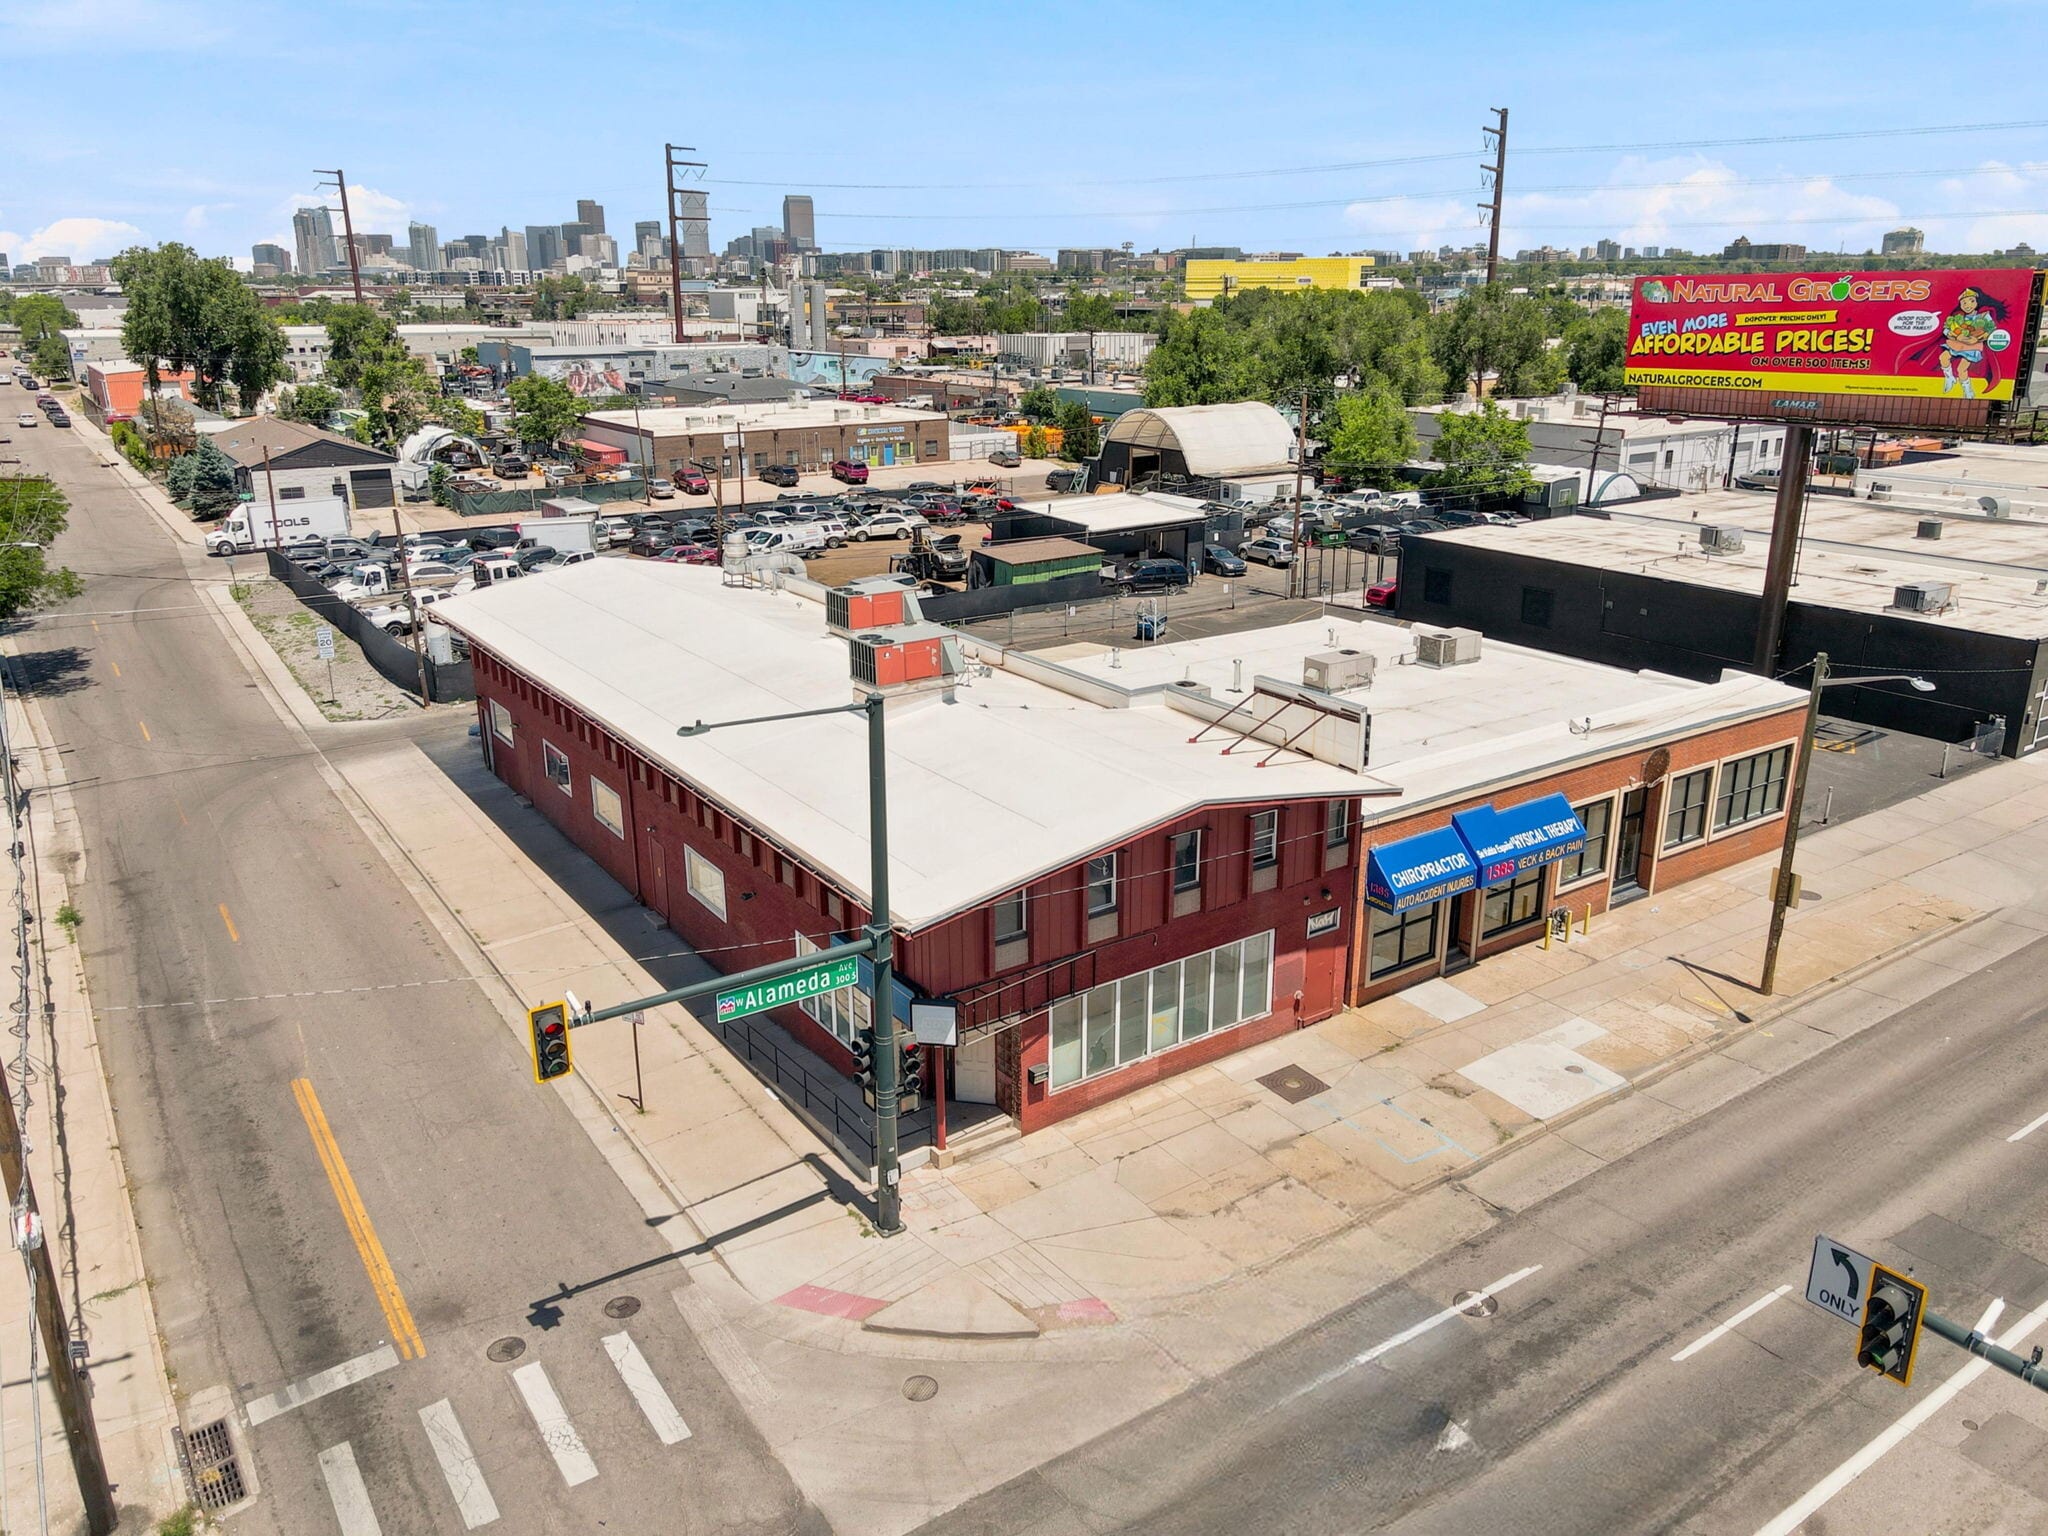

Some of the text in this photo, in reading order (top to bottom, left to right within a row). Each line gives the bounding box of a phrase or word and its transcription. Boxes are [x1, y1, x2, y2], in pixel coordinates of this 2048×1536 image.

[1672, 279, 1783, 303] NATURAL
[1641, 312, 1728, 337] EVEN MORE
[1630, 328, 1874, 356] AFFORDABLE PRICES!
[1751, 356, 1870, 369] ON OVER 500 ITEMS!
[1628, 373, 1763, 388] NATURALGROCERS.COM
[1775, 400, 1817, 410] LAMAR
[264, 517, 311, 529] TOOLS
[1543, 817, 1580, 840] THERAPY
[1545, 844, 1567, 861] BACK
[1566, 839, 1584, 854] PAIN
[1391, 852, 1470, 888] CHIROPRACTOR
[1396, 893, 1415, 911] AUTO
[1414, 884, 1447, 905] ACCIDENT
[1446, 874, 1475, 894] INJURIES
[735, 962, 853, 1010] W Alameda Ave
[835, 974, 851, 986] 300
[1819, 1289, 1860, 1318] ONLY
